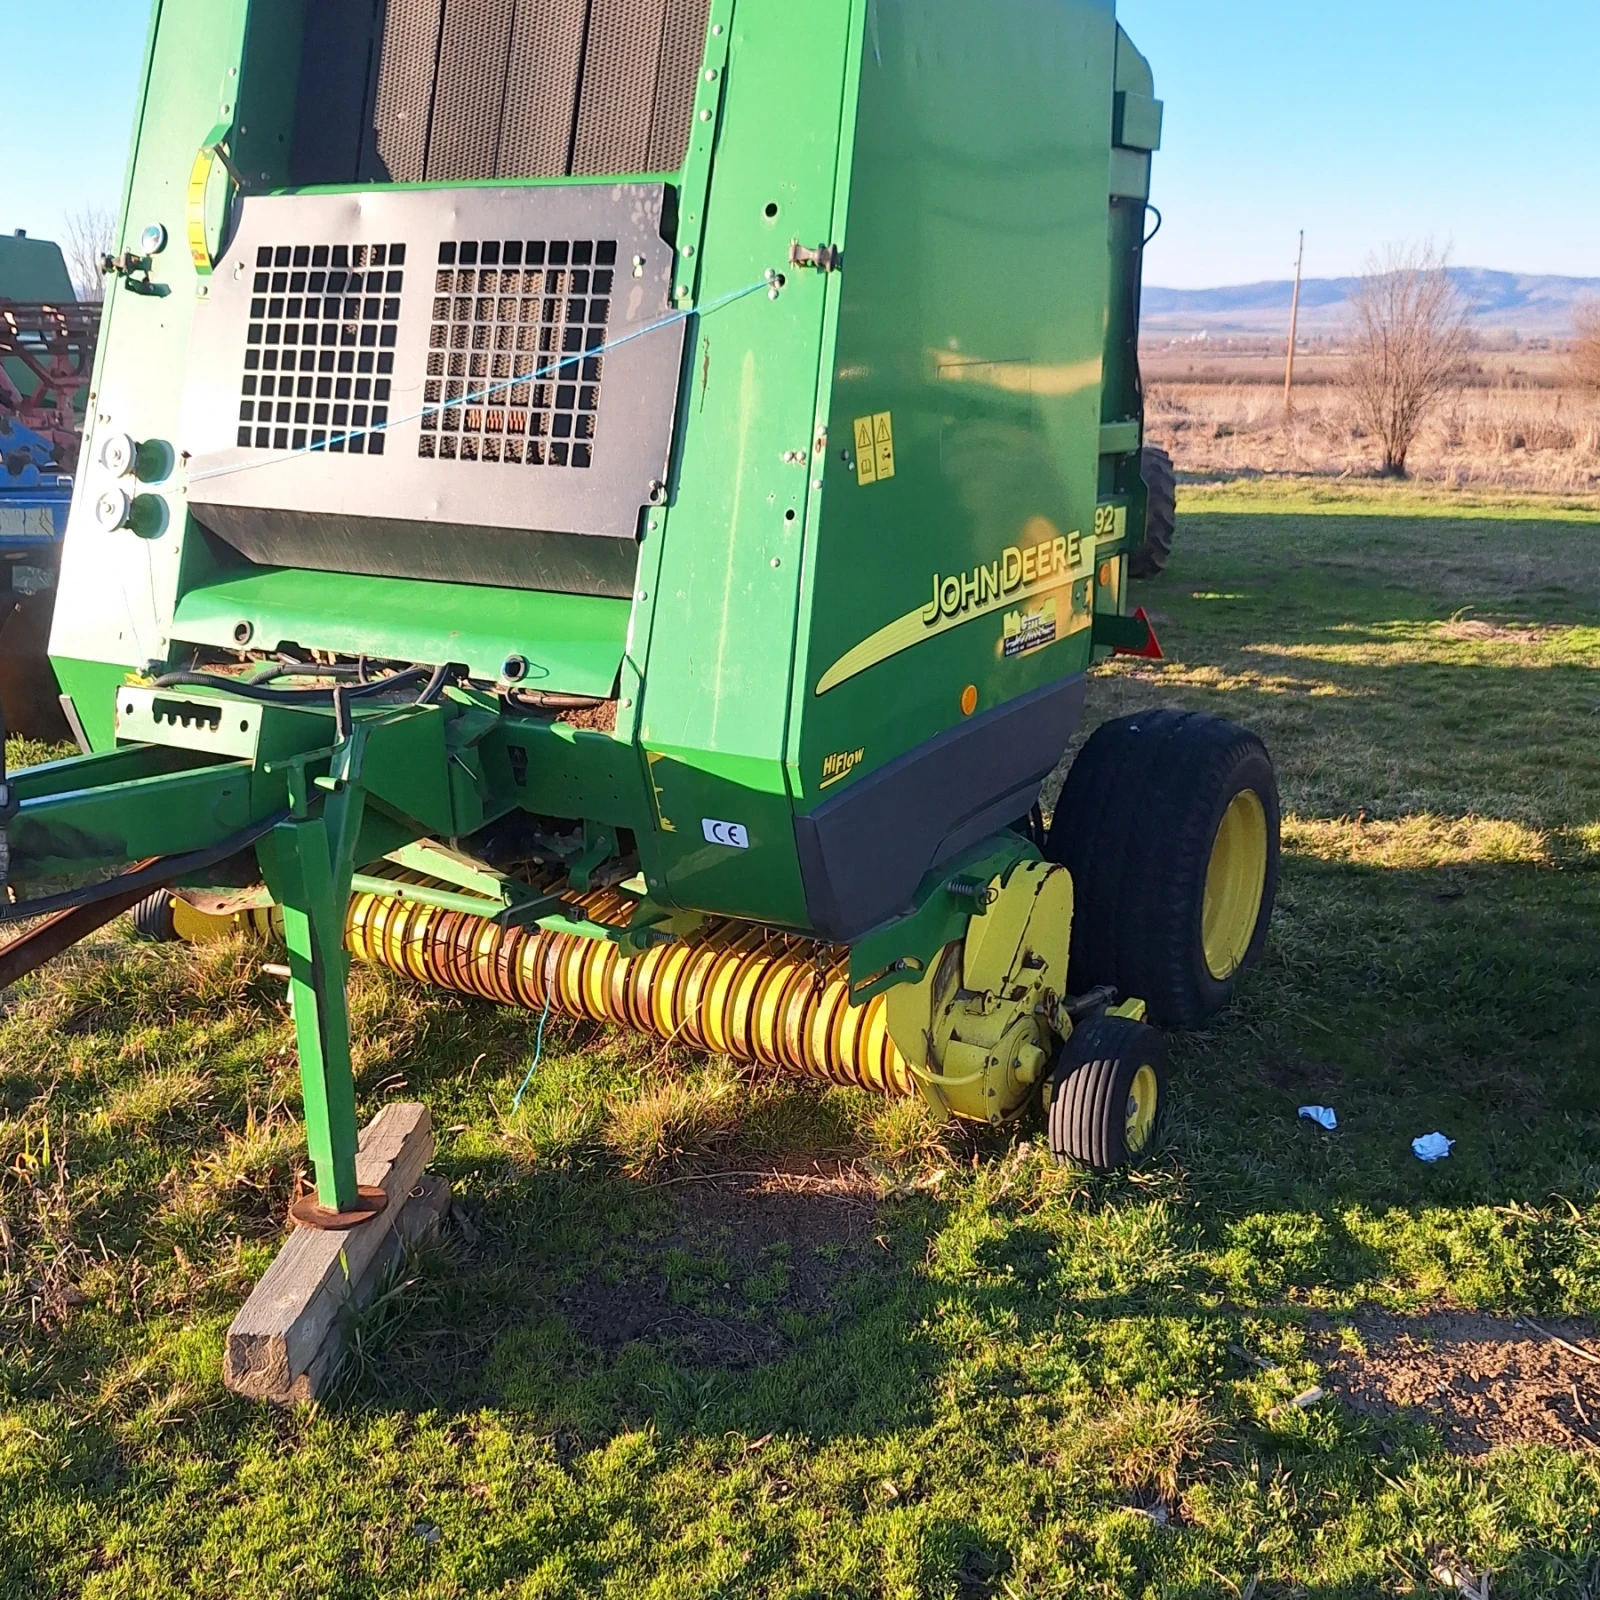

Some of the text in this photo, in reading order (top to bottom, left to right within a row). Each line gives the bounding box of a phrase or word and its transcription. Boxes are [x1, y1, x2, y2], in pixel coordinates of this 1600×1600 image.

[922, 530, 1081, 624] JOHN DEERE
[712, 822, 741, 846] CE
